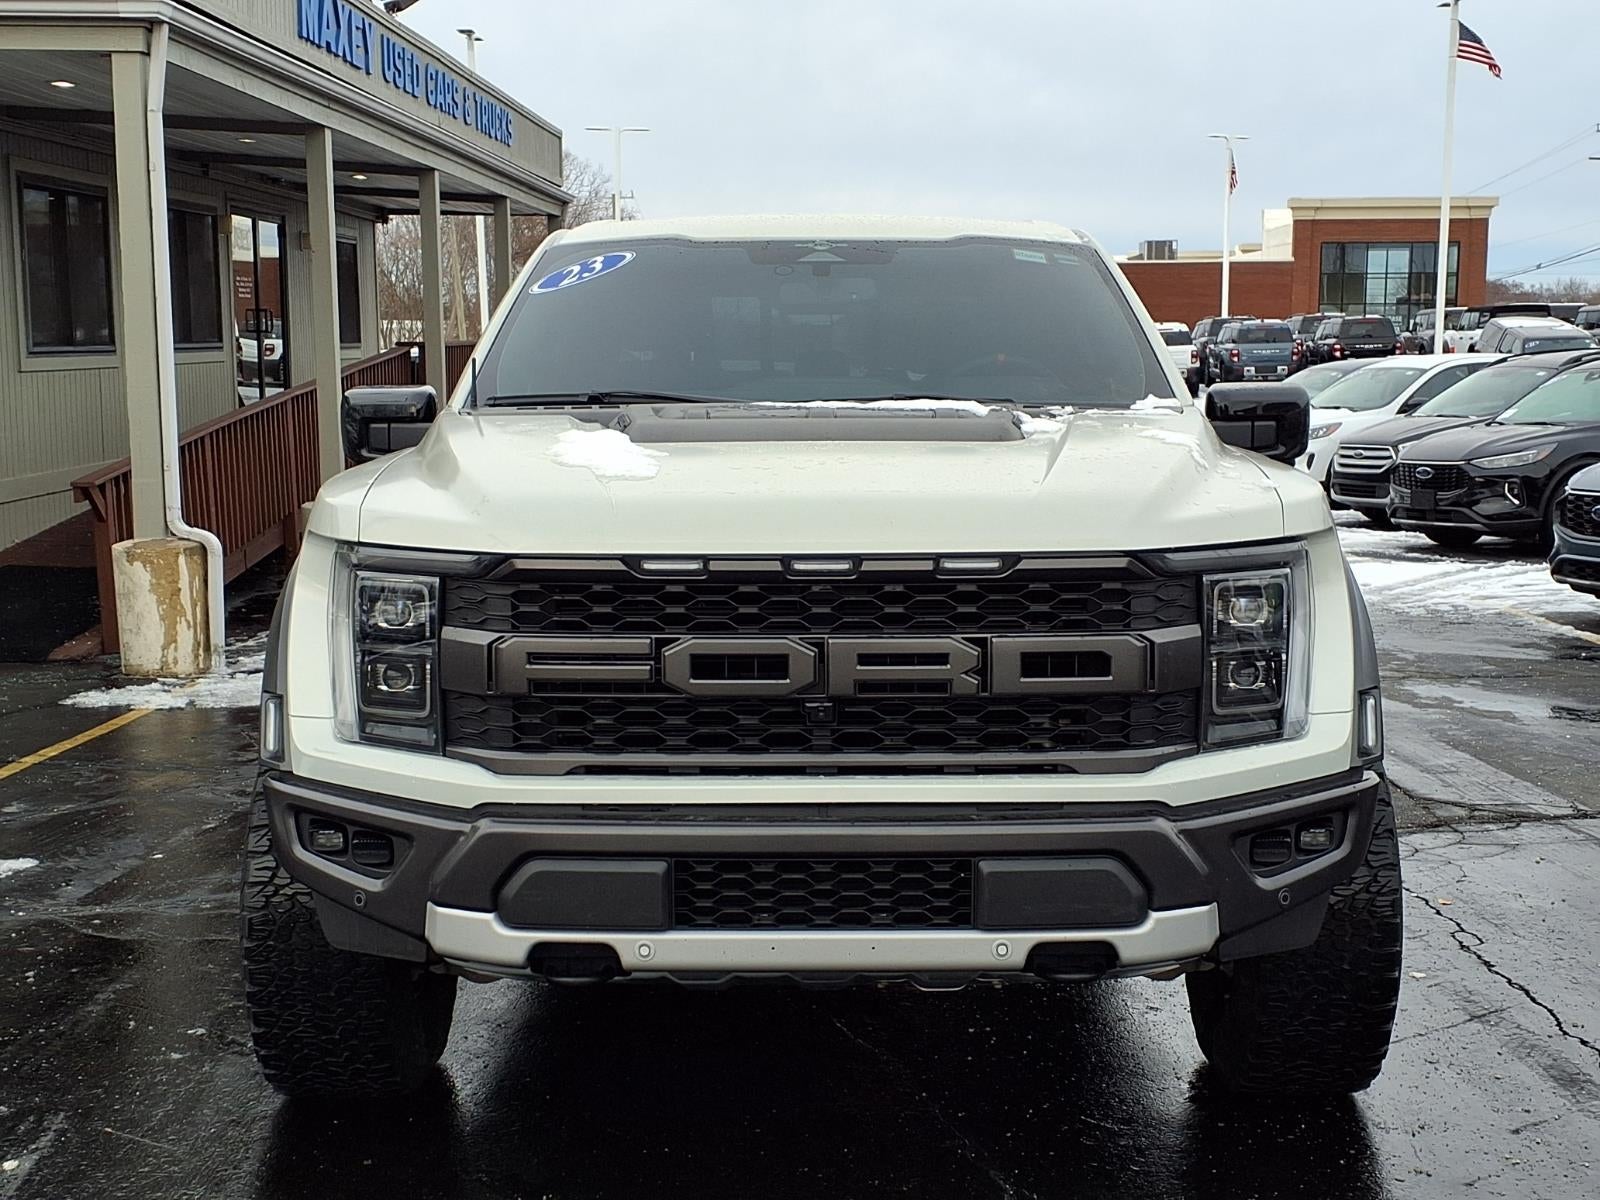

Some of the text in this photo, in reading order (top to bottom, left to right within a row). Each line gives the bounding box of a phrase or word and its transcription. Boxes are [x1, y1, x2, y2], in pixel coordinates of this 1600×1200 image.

[297, 0, 513, 147] MAXEY USED CARS & TRUCKS
[558, 256, 604, 287] 23
[492, 635, 1147, 697] FORD
